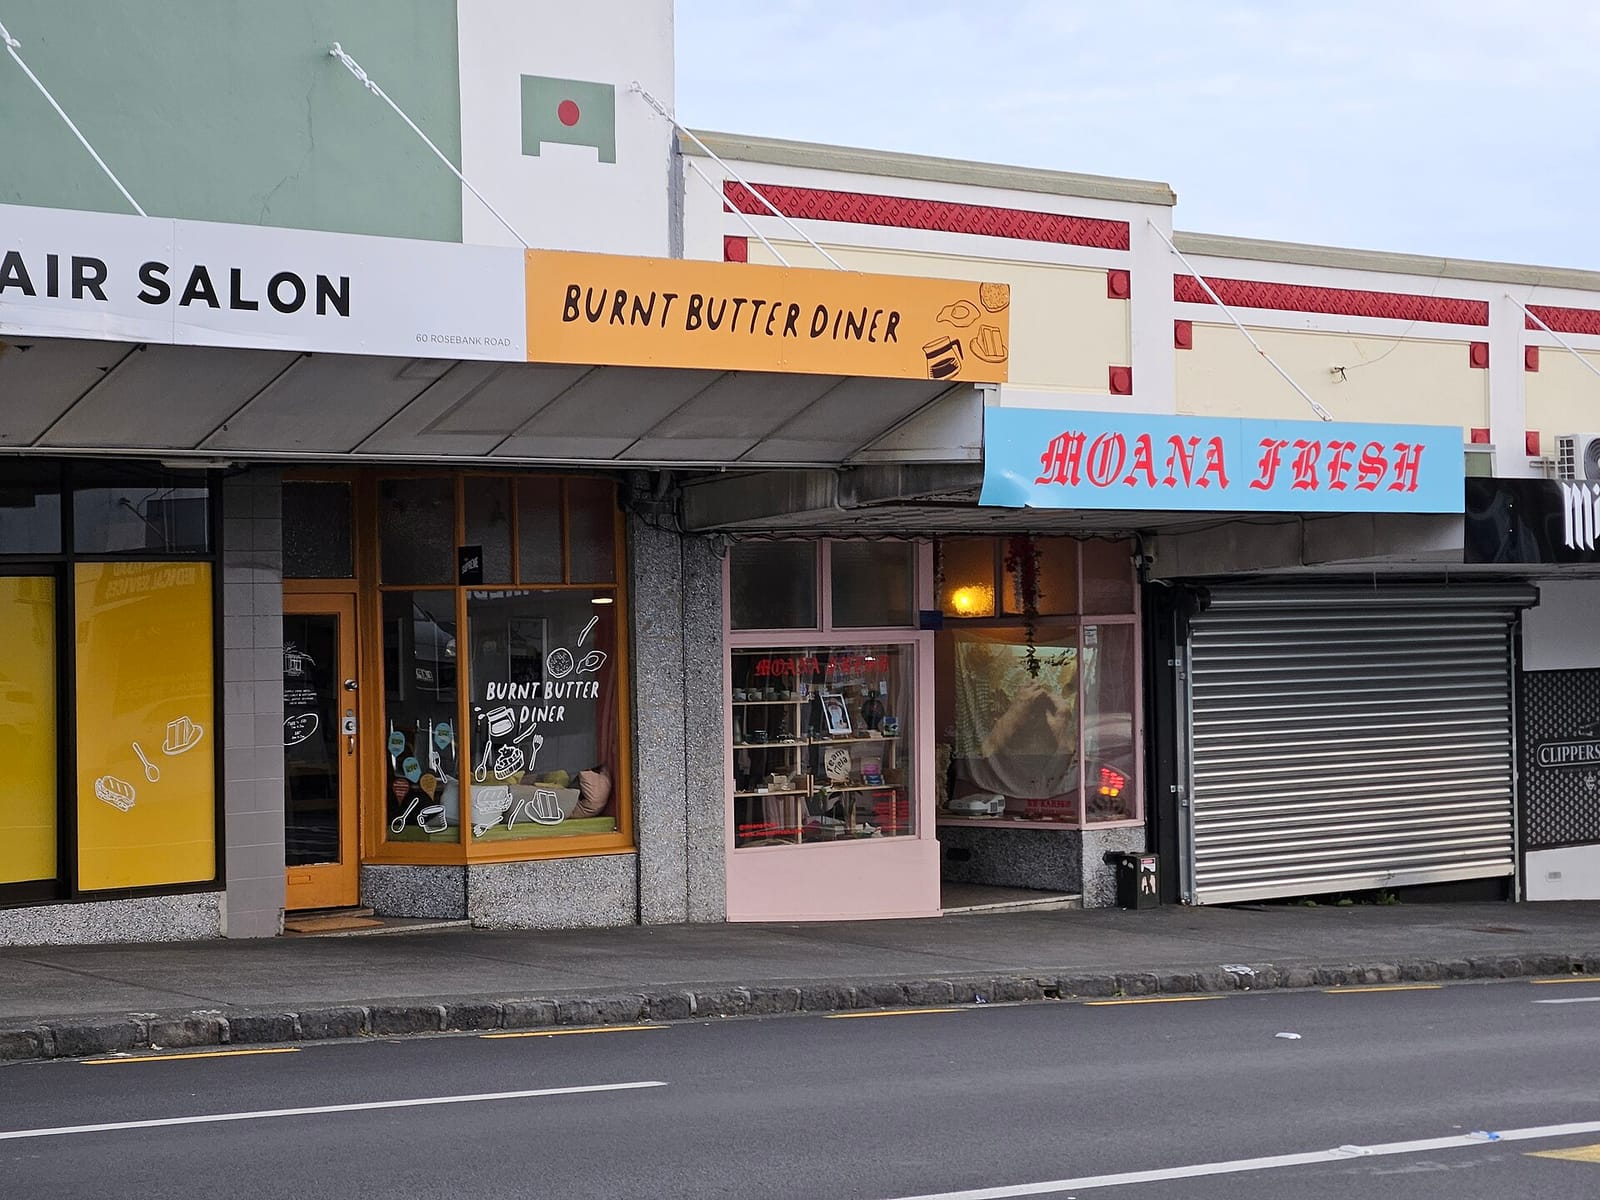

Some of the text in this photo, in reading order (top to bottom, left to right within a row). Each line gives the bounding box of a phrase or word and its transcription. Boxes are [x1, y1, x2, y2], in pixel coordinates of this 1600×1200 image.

[137, 260, 350, 317] SALON
[562, 284, 900, 343] BURNT BUTTER DINER
[416, 333, 511, 348] 60 ROSEBANK ROAD
[1035, 431, 1424, 493] MOANA FRESH
[486, 680, 599, 700] BURNT BUTTER
[520, 705, 565, 723] DINER
